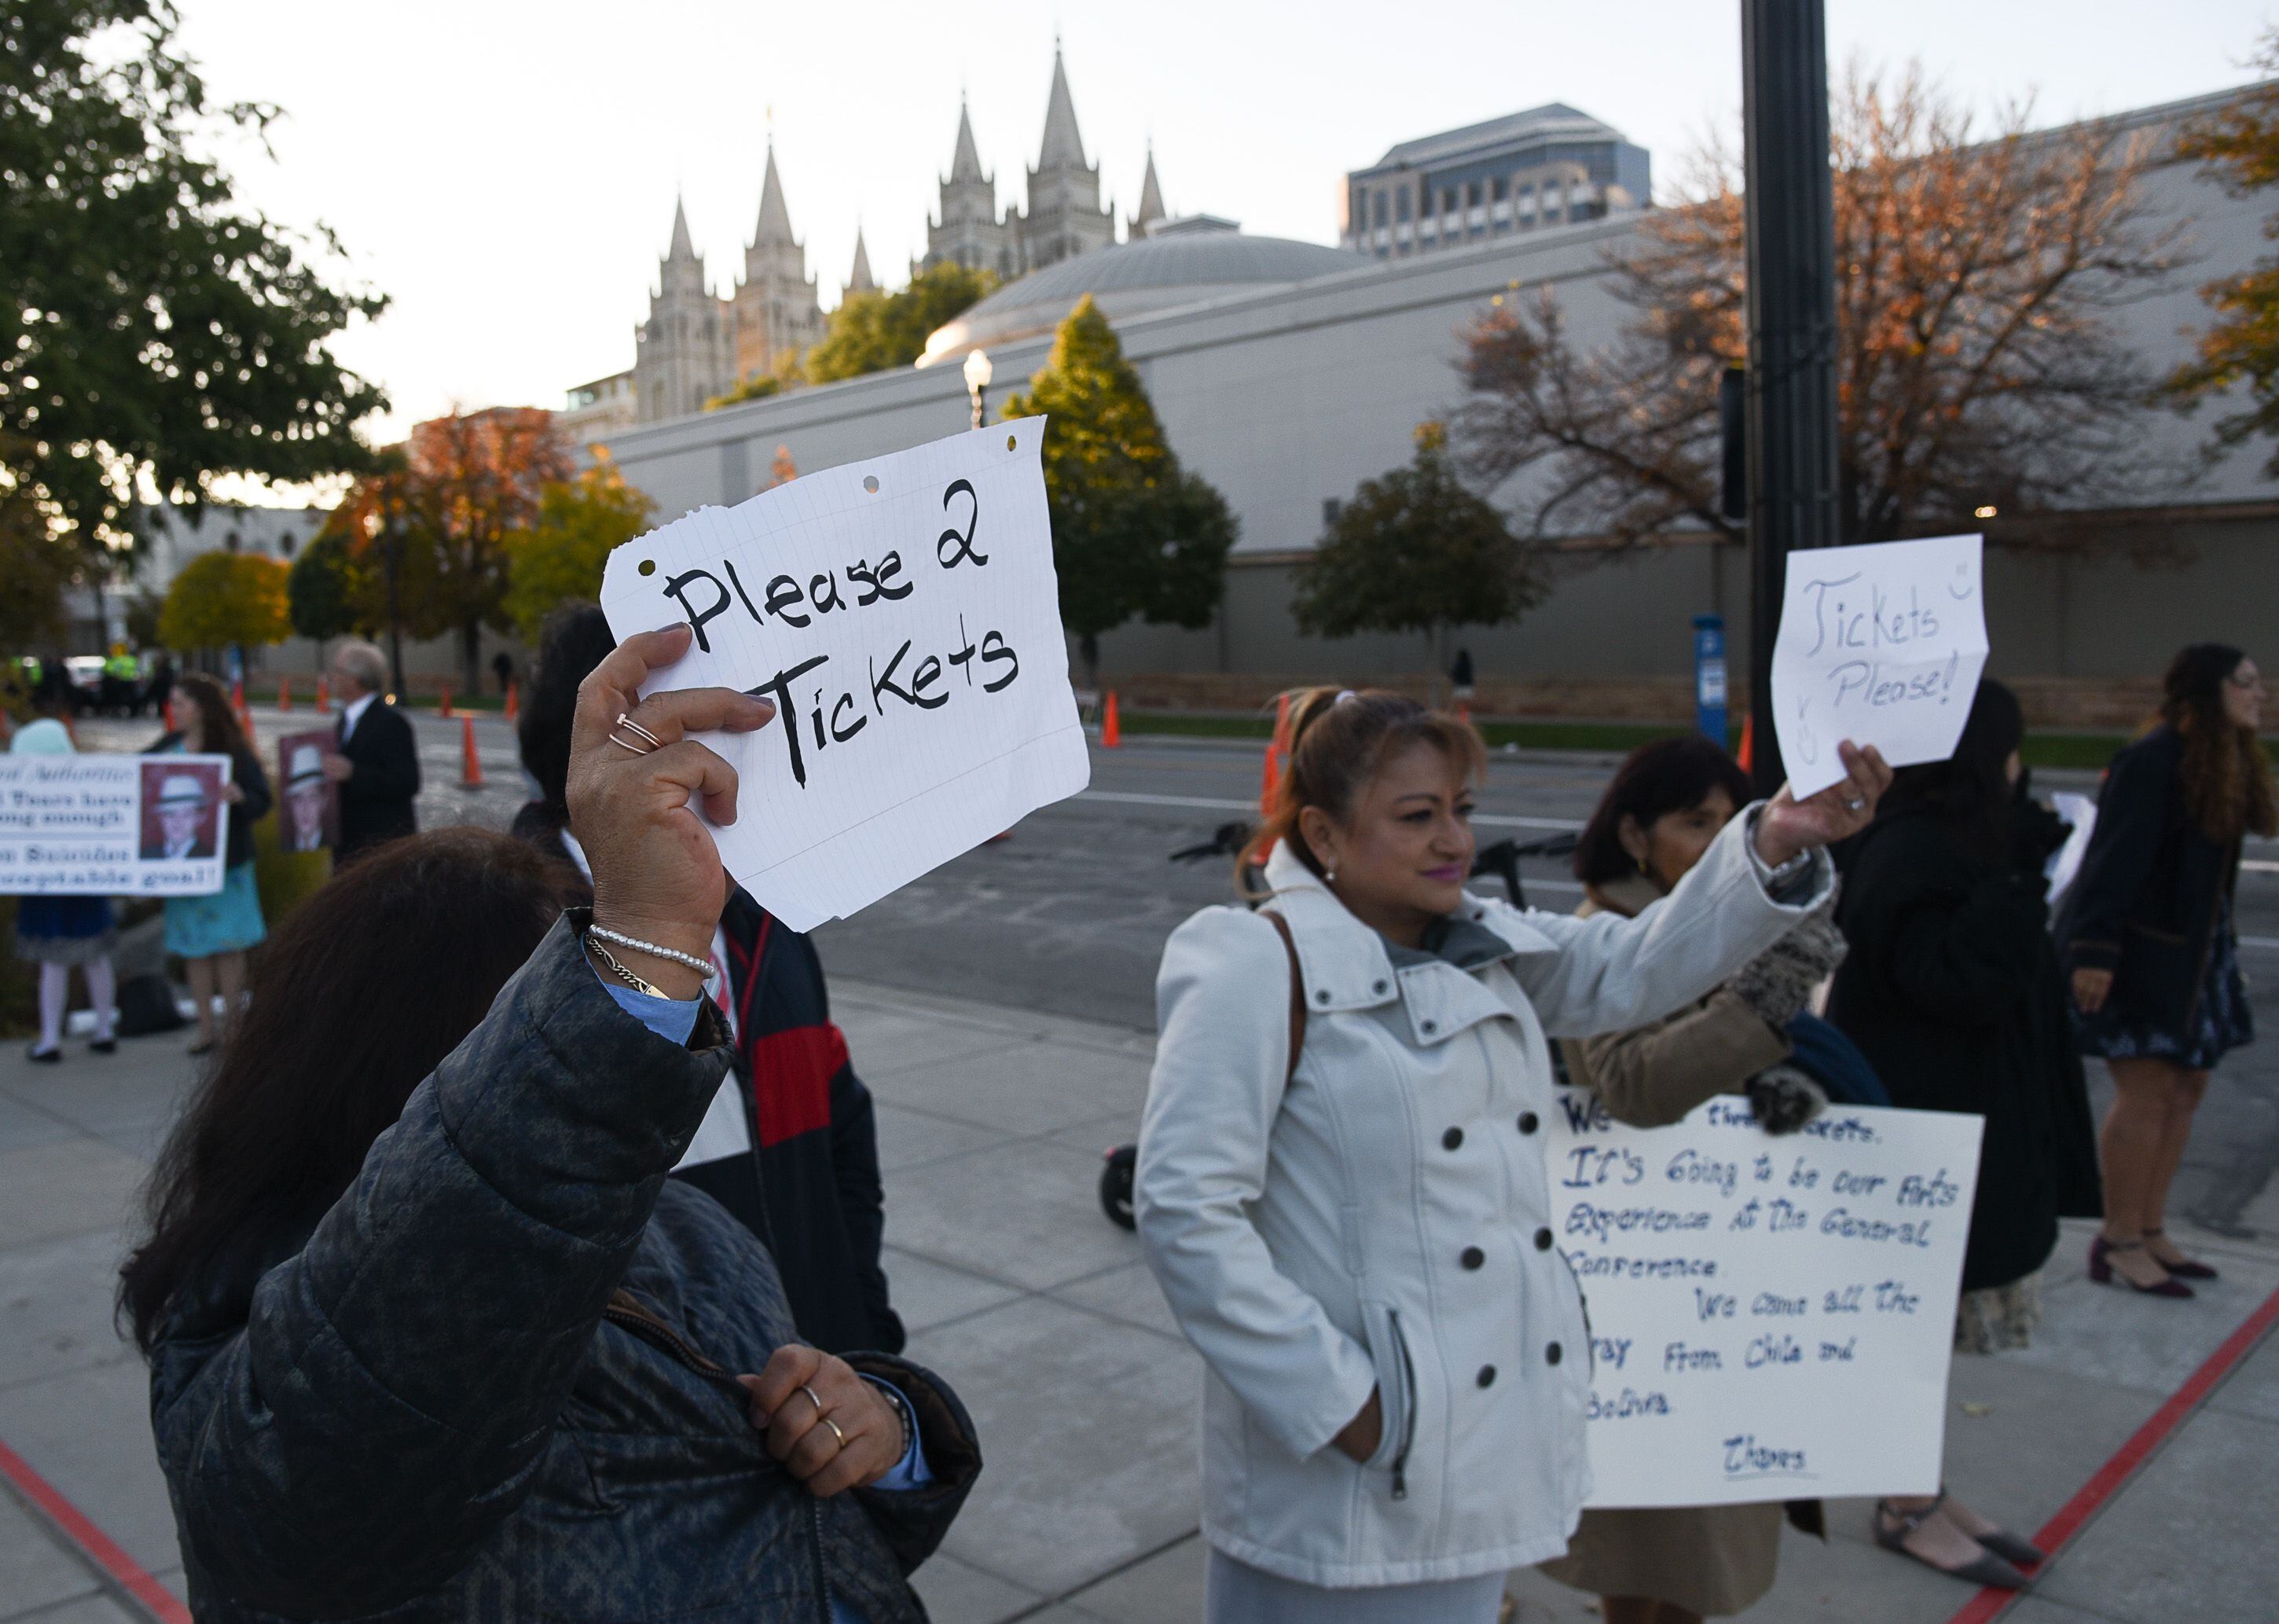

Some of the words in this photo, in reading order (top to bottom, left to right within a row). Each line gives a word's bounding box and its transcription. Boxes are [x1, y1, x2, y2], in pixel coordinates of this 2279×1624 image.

[663, 550, 914, 653] Please
[937, 478, 989, 569] 2
[1804, 571, 1940, 658] Tickets
[741, 613, 1019, 789] Tickets
[1826, 649, 1959, 708] Please!
[1752, 1153, 1773, 1181] to
[1788, 1156, 1820, 1189] be
[1694, 1287, 1736, 1322] We
[1823, 1283, 1864, 1314] all
[1745, 1333, 1802, 1369] Chile
[1818, 1335, 1857, 1362] and
